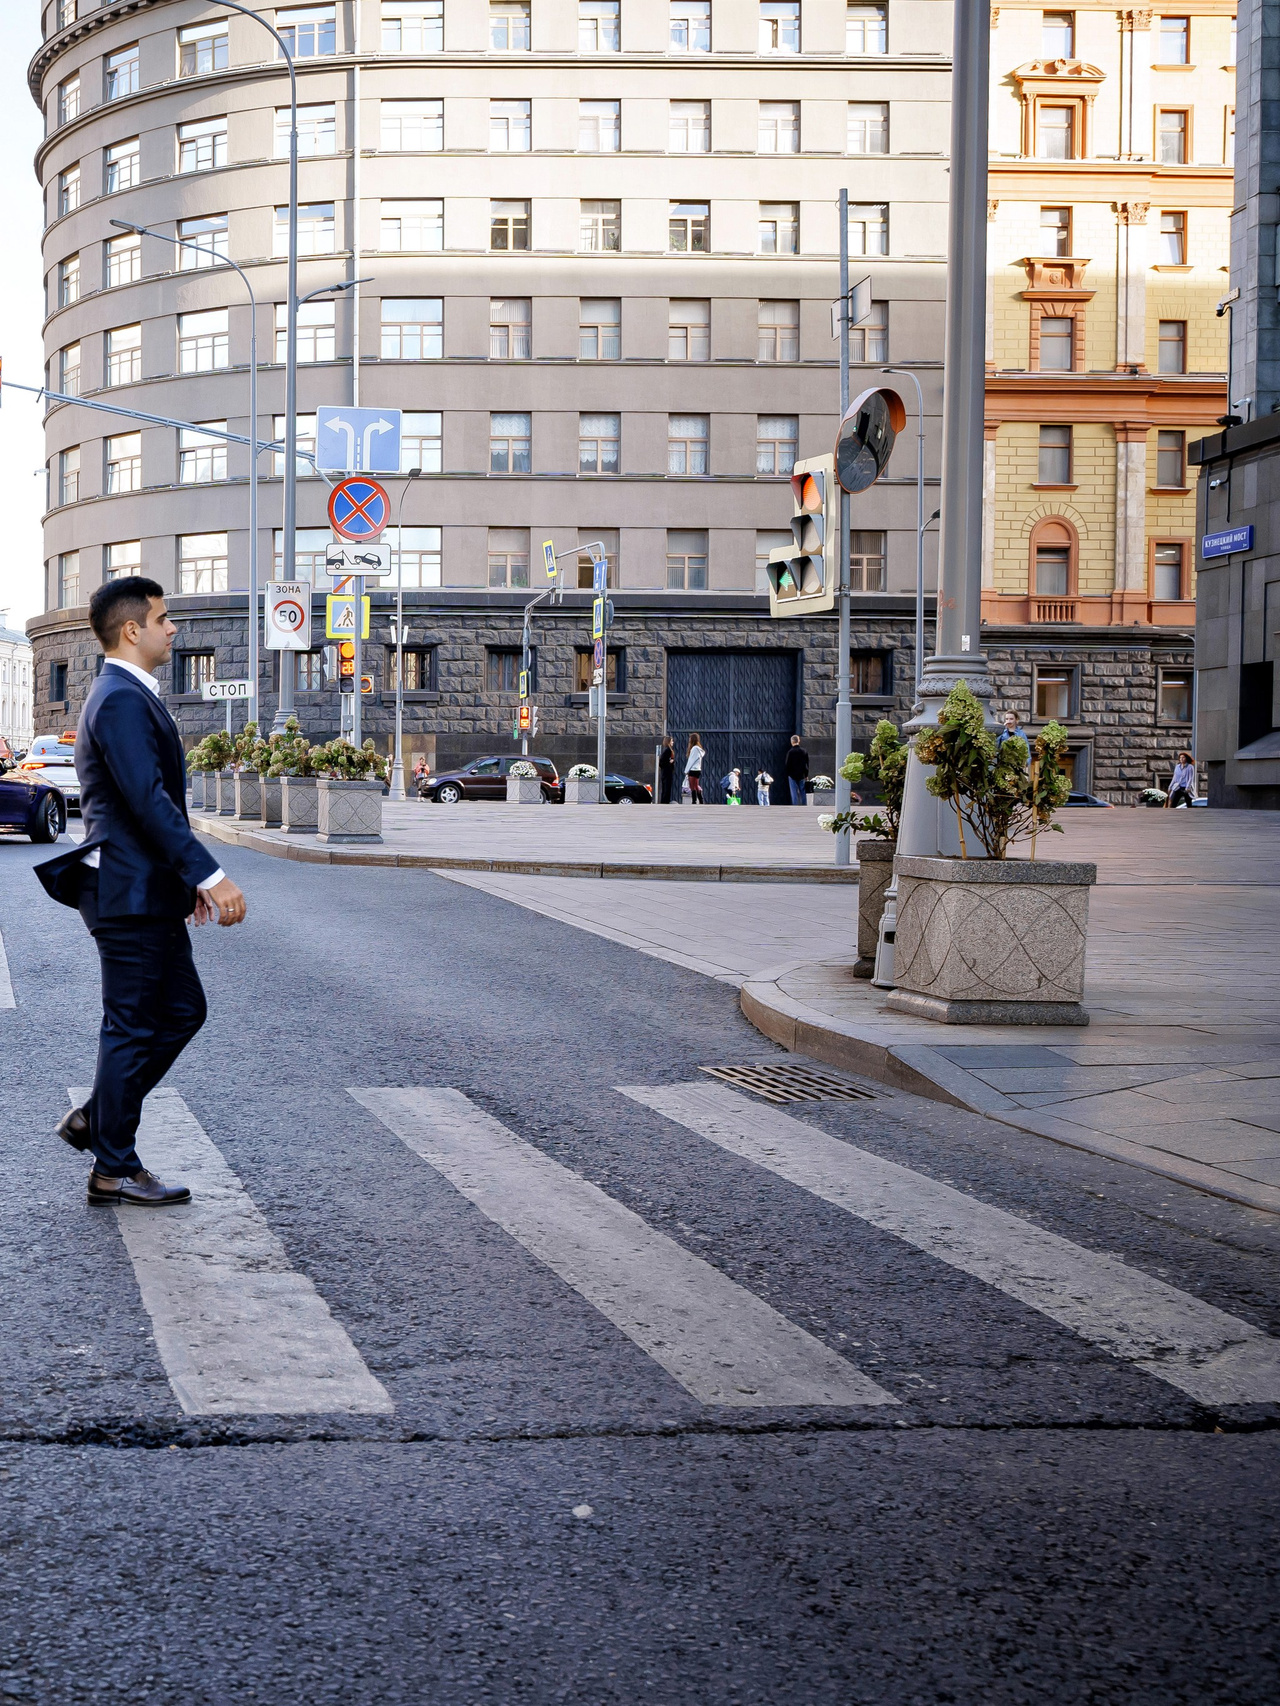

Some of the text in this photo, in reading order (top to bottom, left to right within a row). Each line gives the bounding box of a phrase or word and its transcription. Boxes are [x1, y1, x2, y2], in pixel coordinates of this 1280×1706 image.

[1205, 534, 1233, 548] КУЗНЕЦКИЙ
[1234, 532, 1247, 542] МОСТ
[275, 585, 301, 594] ЗОНА
[279, 610, 297, 623] 50
[341, 661, 354, 674] 28
[209, 683, 247, 697] СТОП
